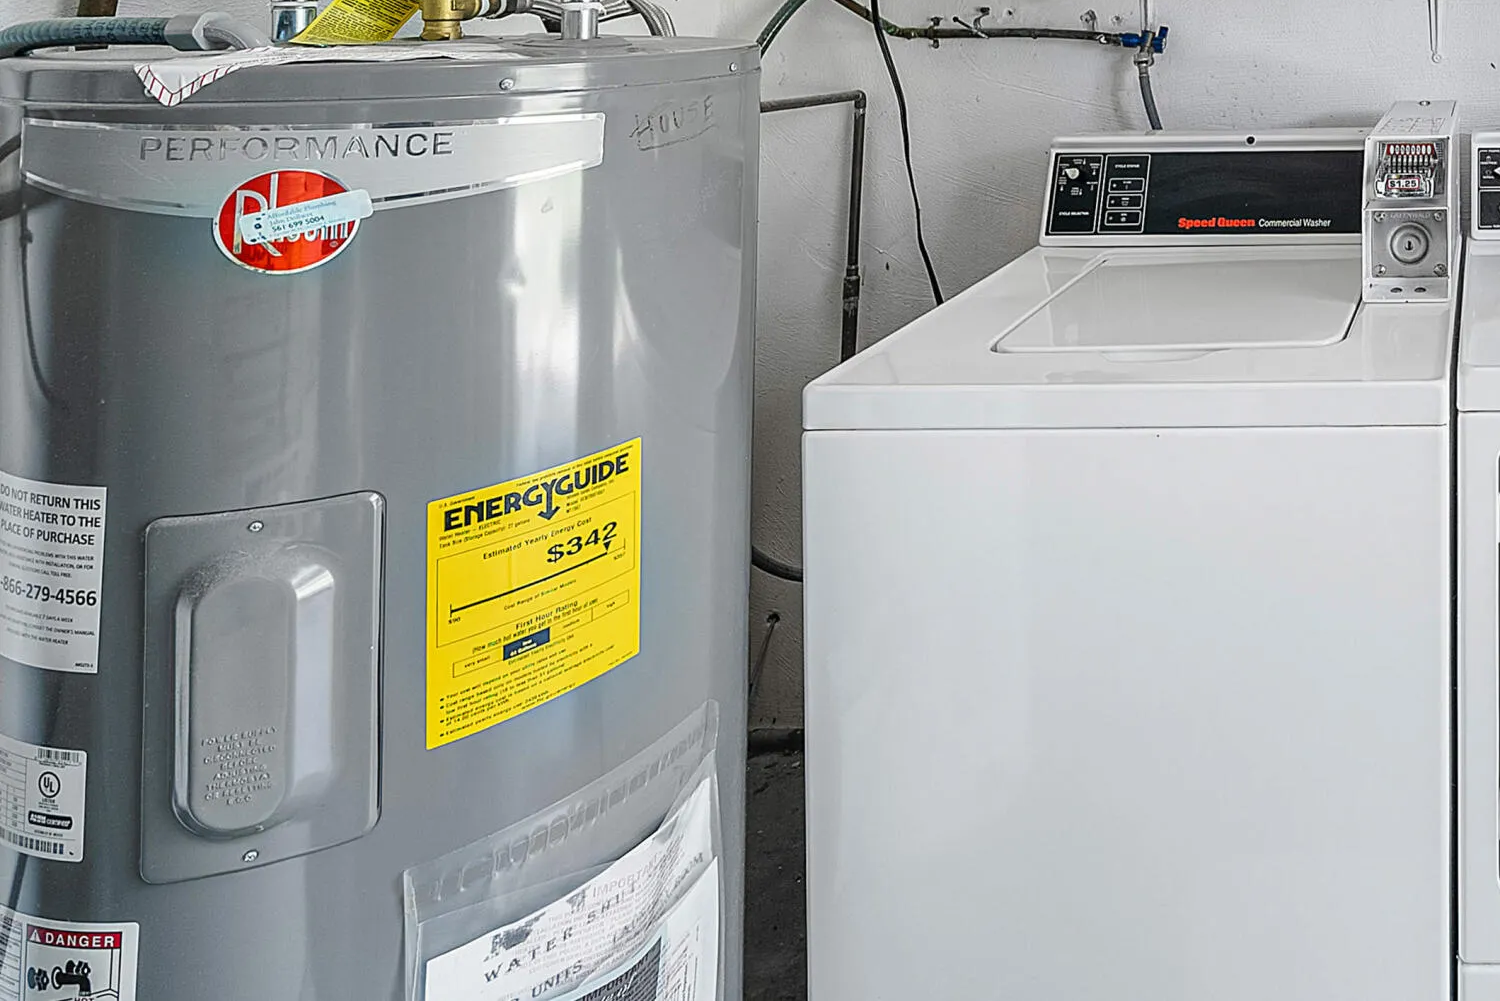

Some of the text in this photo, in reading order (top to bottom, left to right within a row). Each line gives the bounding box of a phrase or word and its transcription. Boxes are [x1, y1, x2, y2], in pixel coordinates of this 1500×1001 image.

[140, 132, 454, 161] PERFORMANCE
[1389, 180, 1417, 188] $1.25
[288, 221, 303, 229] 699
[305, 215, 325, 224] 5004
[1178, 217, 1332, 230] Speed Queen Commercial Washer
[0, 483, 101, 511] DO NOT RETURN THIS
[444, 452, 629, 532] ENERGYGUIDE
[0, 501, 102, 528] WATER HEATER TO THE
[0, 519, 95, 546] PLACE OF PURCHASE
[483, 517, 593, 560] Estimated Yearly Energy Cost
[546, 521, 617, 564] $342
[0, 575, 97, 607] -866-279-4566
[515, 618, 533, 631] First
[535, 611, 553, 622] Hour
[43, 776, 55, 793] UL
[45, 932, 115, 948] DANGER
[484, 929, 574, 984] WATER
[531, 960, 584, 998] UNITS
